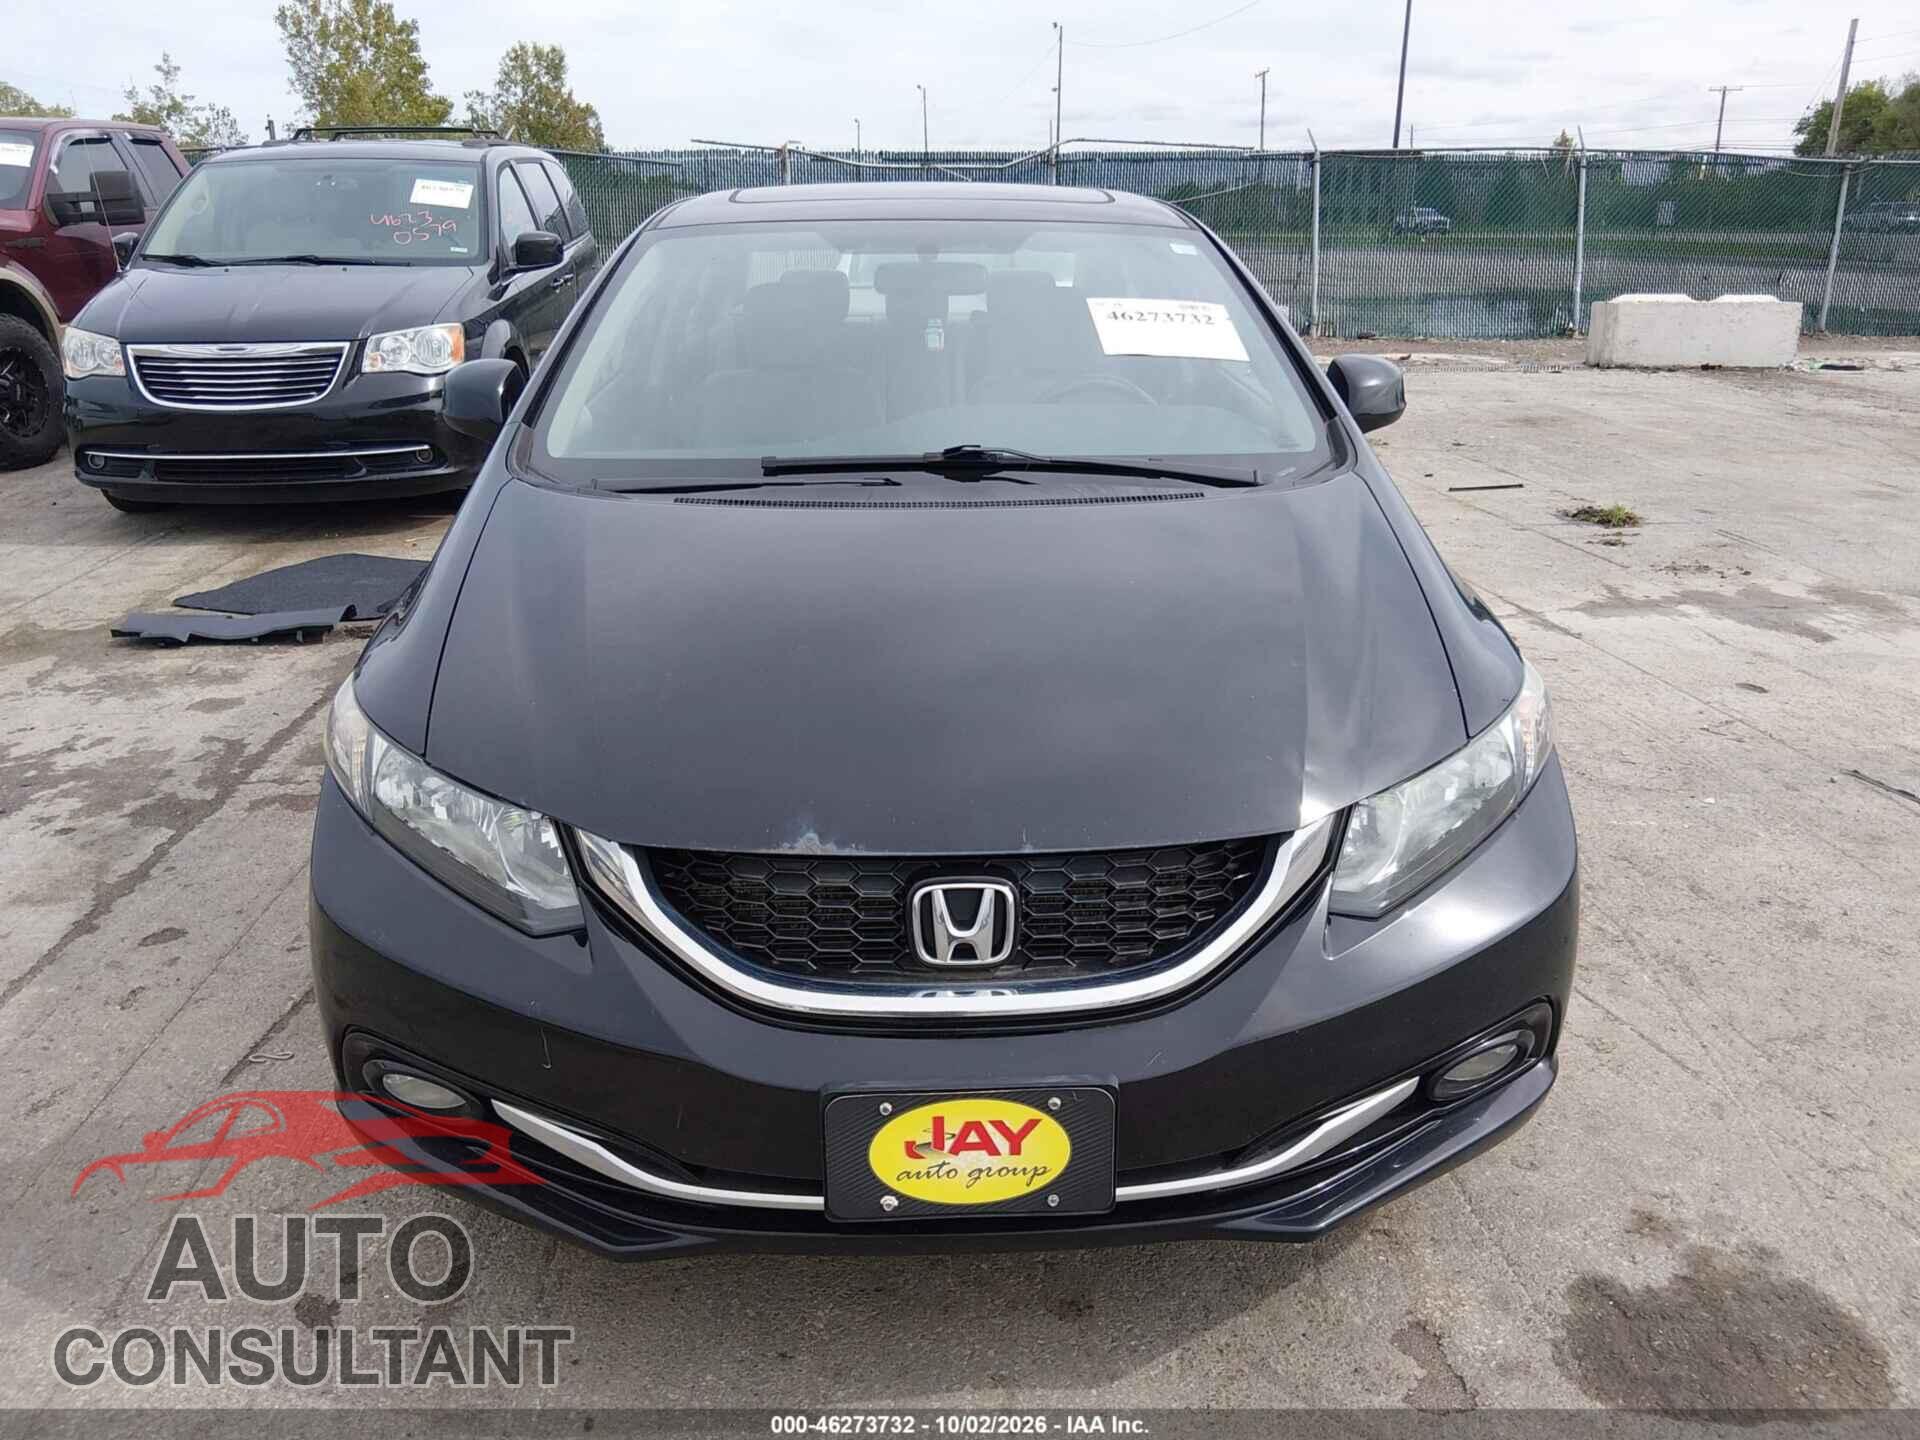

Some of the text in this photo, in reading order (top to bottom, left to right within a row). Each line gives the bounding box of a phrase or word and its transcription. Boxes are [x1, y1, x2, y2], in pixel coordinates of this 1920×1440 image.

[1107, 310, 1215, 325] 46273732
[903, 1115, 1043, 1160] JAY
[896, 1159, 1051, 1188] auto group
